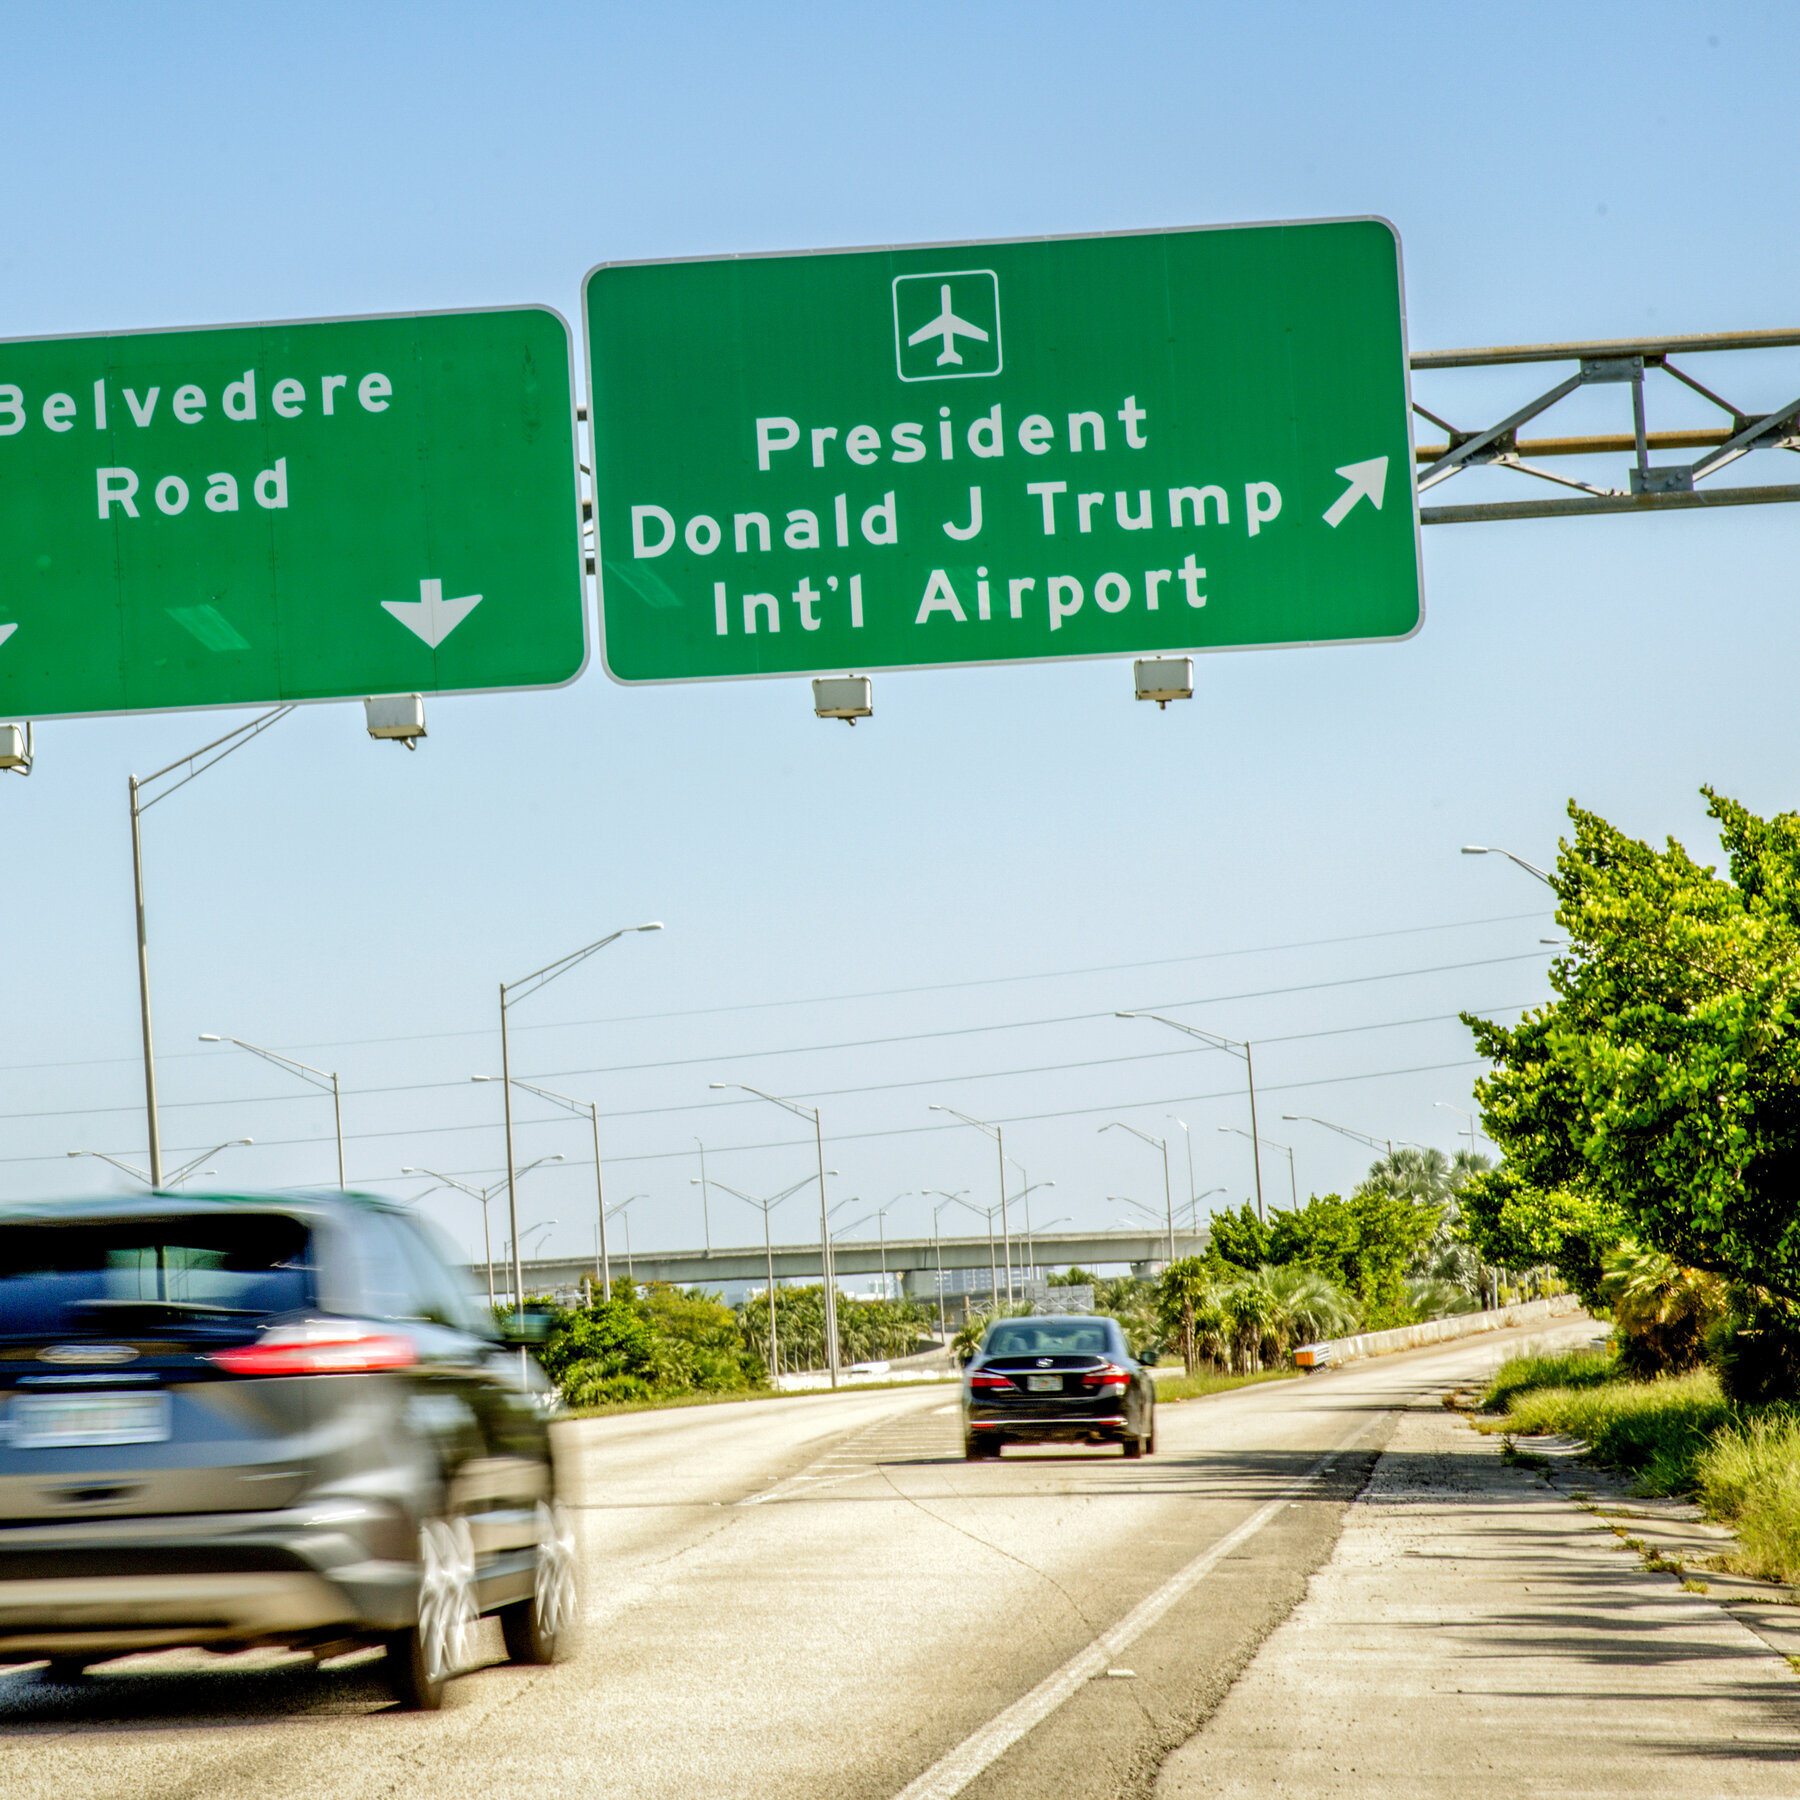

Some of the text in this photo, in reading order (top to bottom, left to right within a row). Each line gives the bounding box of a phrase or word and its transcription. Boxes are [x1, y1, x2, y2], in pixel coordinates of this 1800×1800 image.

[0, 369, 392, 436] Belvedere
[756, 395, 1147, 471] President
[96, 457, 288, 519] Road
[631, 481, 1282, 559] Donald J Trump
[714, 554, 1207, 635] Int'l Airport
